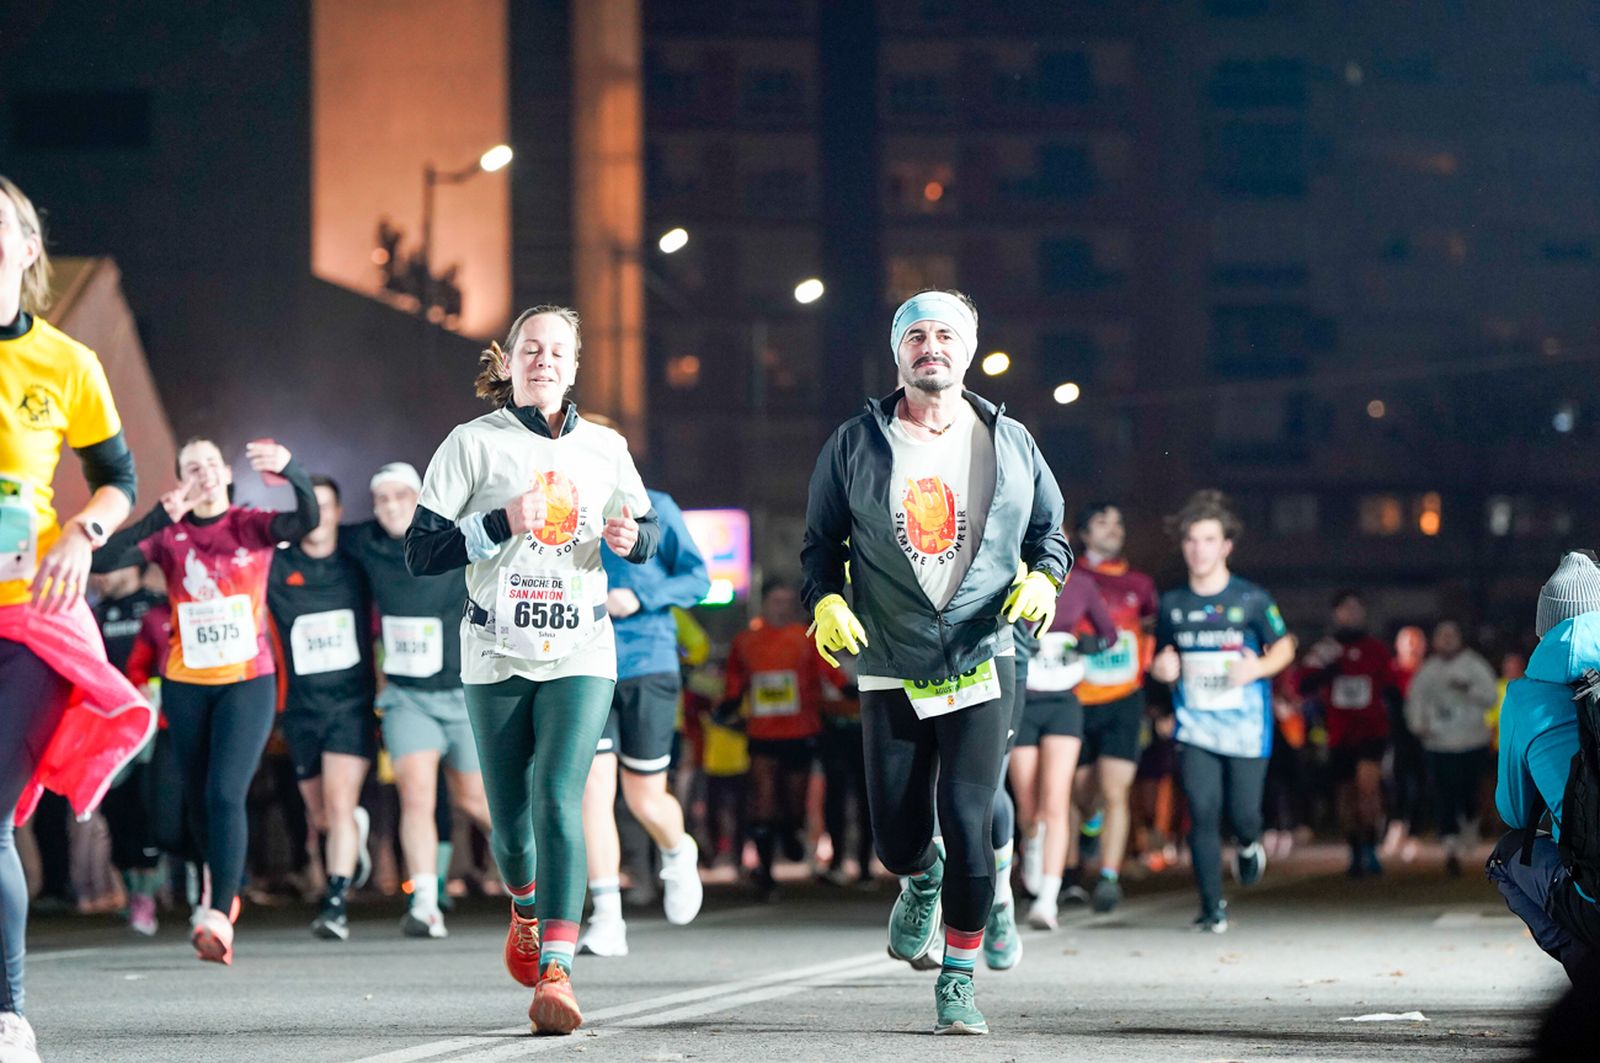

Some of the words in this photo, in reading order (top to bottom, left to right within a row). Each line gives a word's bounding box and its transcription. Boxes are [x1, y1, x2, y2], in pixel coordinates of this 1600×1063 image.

[895, 512, 927, 565] SIEMPRE
[938, 510, 967, 565] SONREIR
[521, 578, 550, 588] NOCHE
[551, 579, 563, 589] DE
[509, 589, 529, 599] SAN
[530, 589, 564, 600] ANTÓN
[514, 601, 580, 630] 6583
[197, 623, 240, 644] 6575
